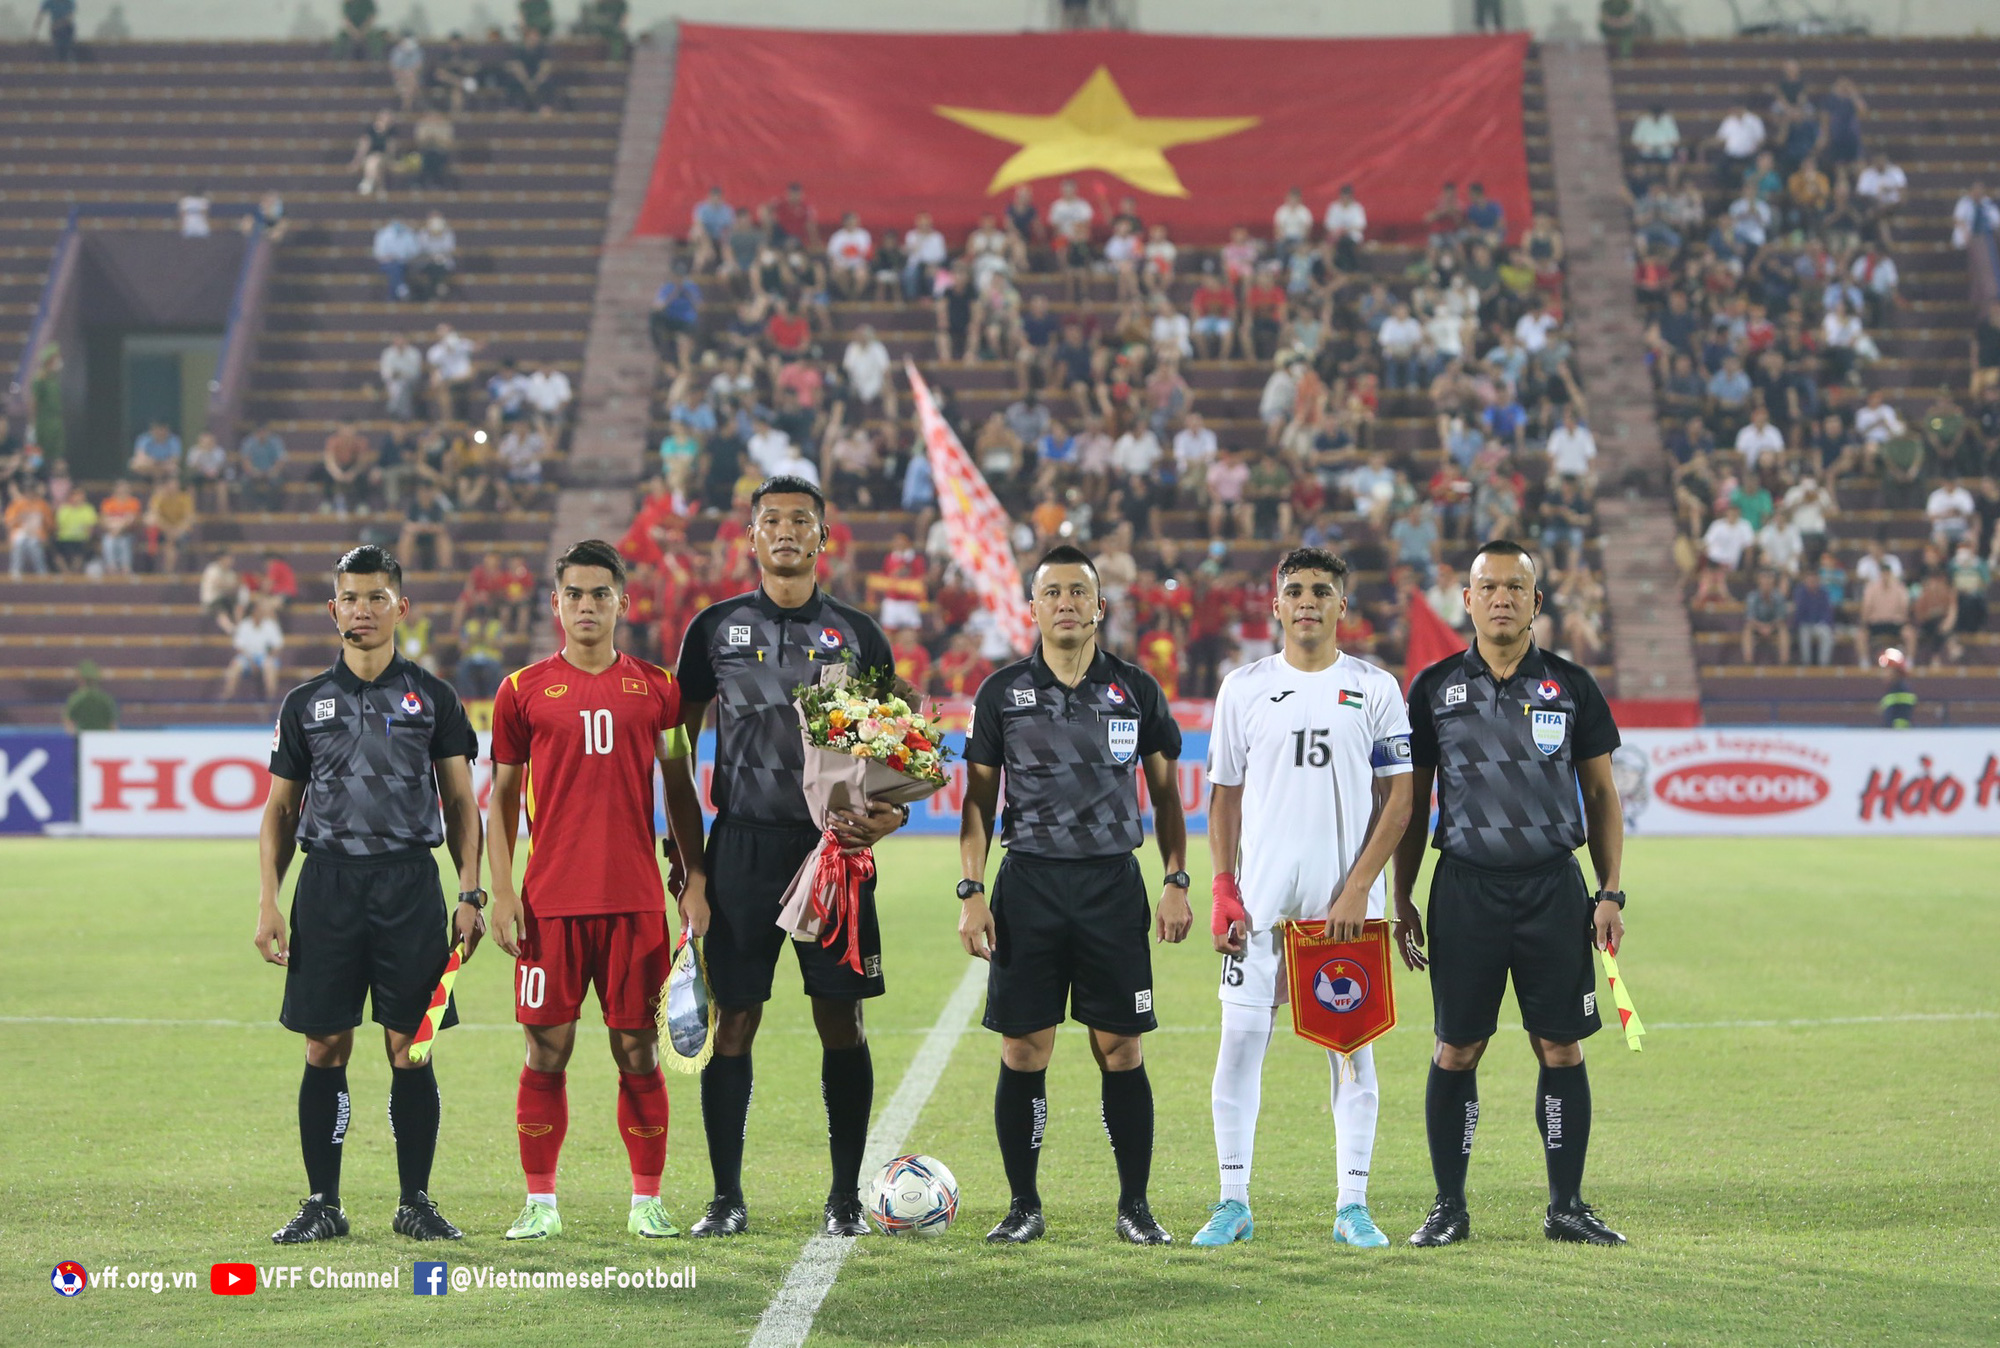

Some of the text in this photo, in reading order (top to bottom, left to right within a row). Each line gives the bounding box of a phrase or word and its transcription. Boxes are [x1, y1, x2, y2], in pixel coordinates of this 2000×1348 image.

[579, 708, 614, 755] 10
[1111, 721, 1135, 731] FIFA
[1535, 713, 1562, 724] FIFA
[1291, 727, 1332, 768] 15
[519, 964, 546, 1009] 10
[1222, 954, 1245, 987] 15
[1334, 998, 1351, 1006] VFF
[331, 1091, 350, 1144] JOGARBOLA
[1031, 1098, 1047, 1149] JOGARBOLA
[1462, 1100, 1479, 1154] JOGARBOLA
[1545, 1095, 1562, 1150] JOGARBOLA
